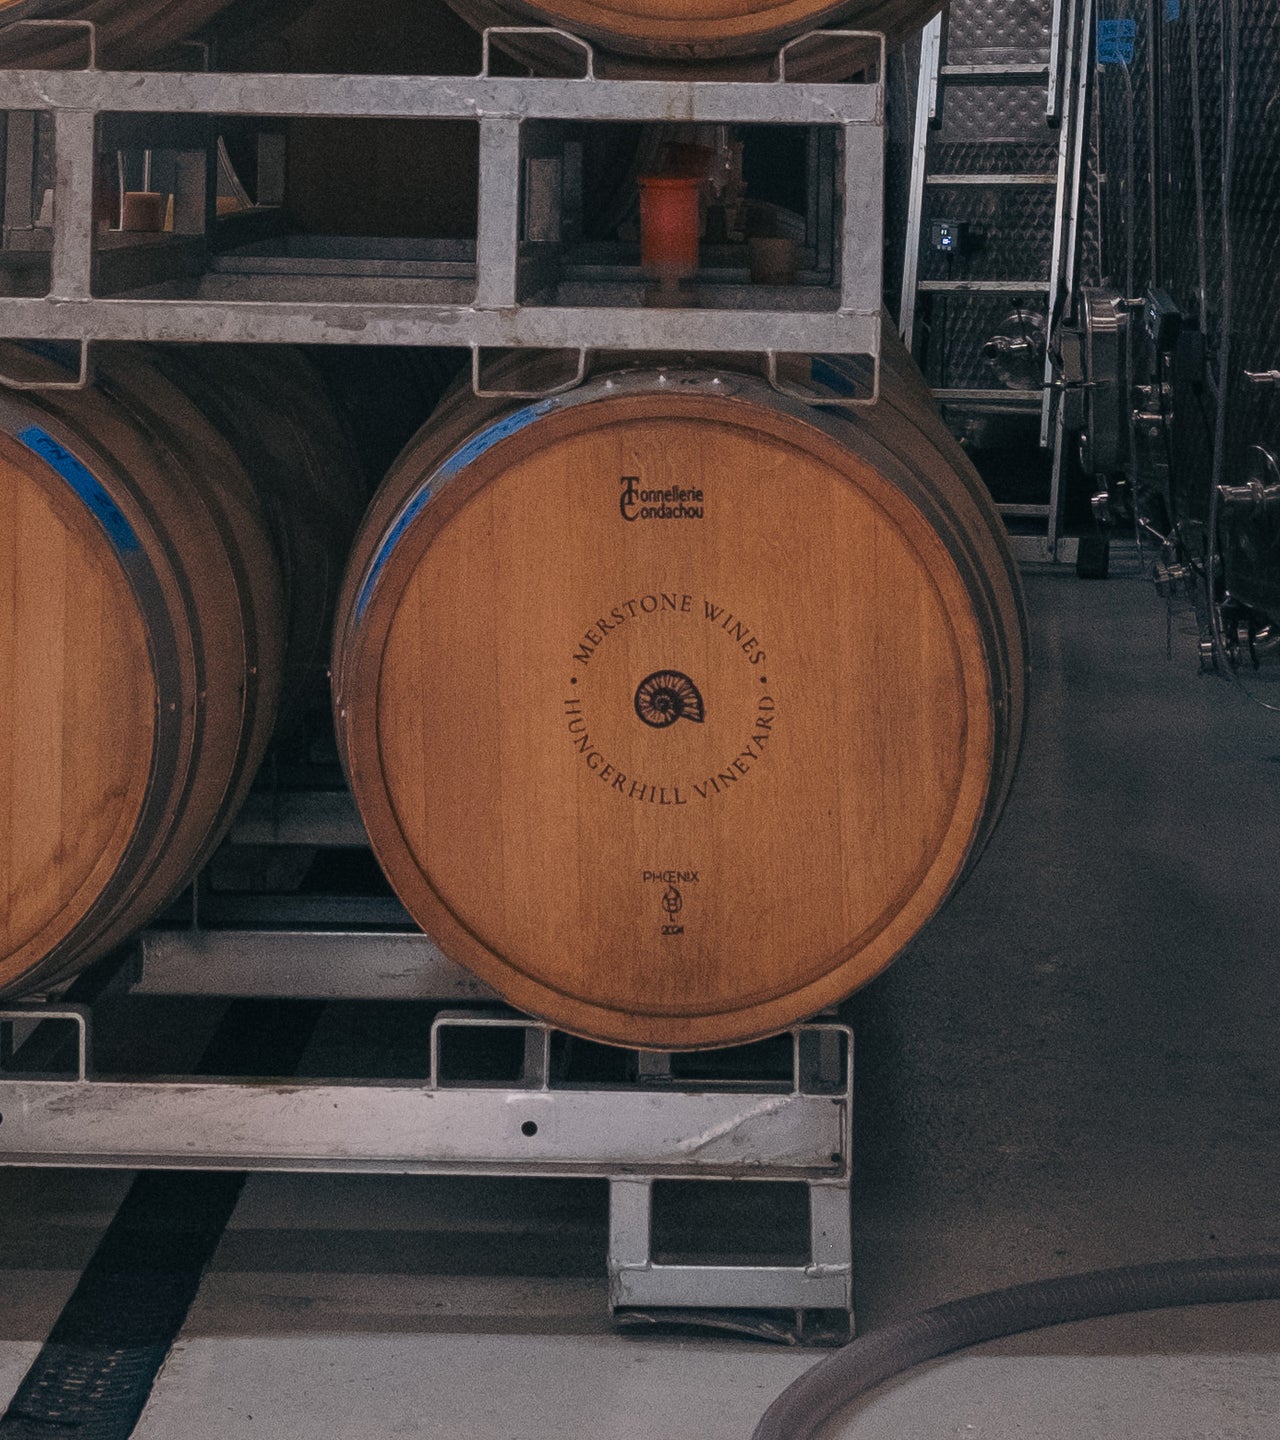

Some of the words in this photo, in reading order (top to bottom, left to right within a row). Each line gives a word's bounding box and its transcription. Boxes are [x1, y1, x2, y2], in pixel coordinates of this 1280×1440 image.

[620, 476, 704, 506] Tonnellerie
[620, 488, 704, 522] Condachou
[572, 593, 693, 666] MERSTONE
[704, 600, 767, 665] WINES
[564, 698, 687, 805] HUNGERHILL
[693, 696, 775, 800] VINEYARD
